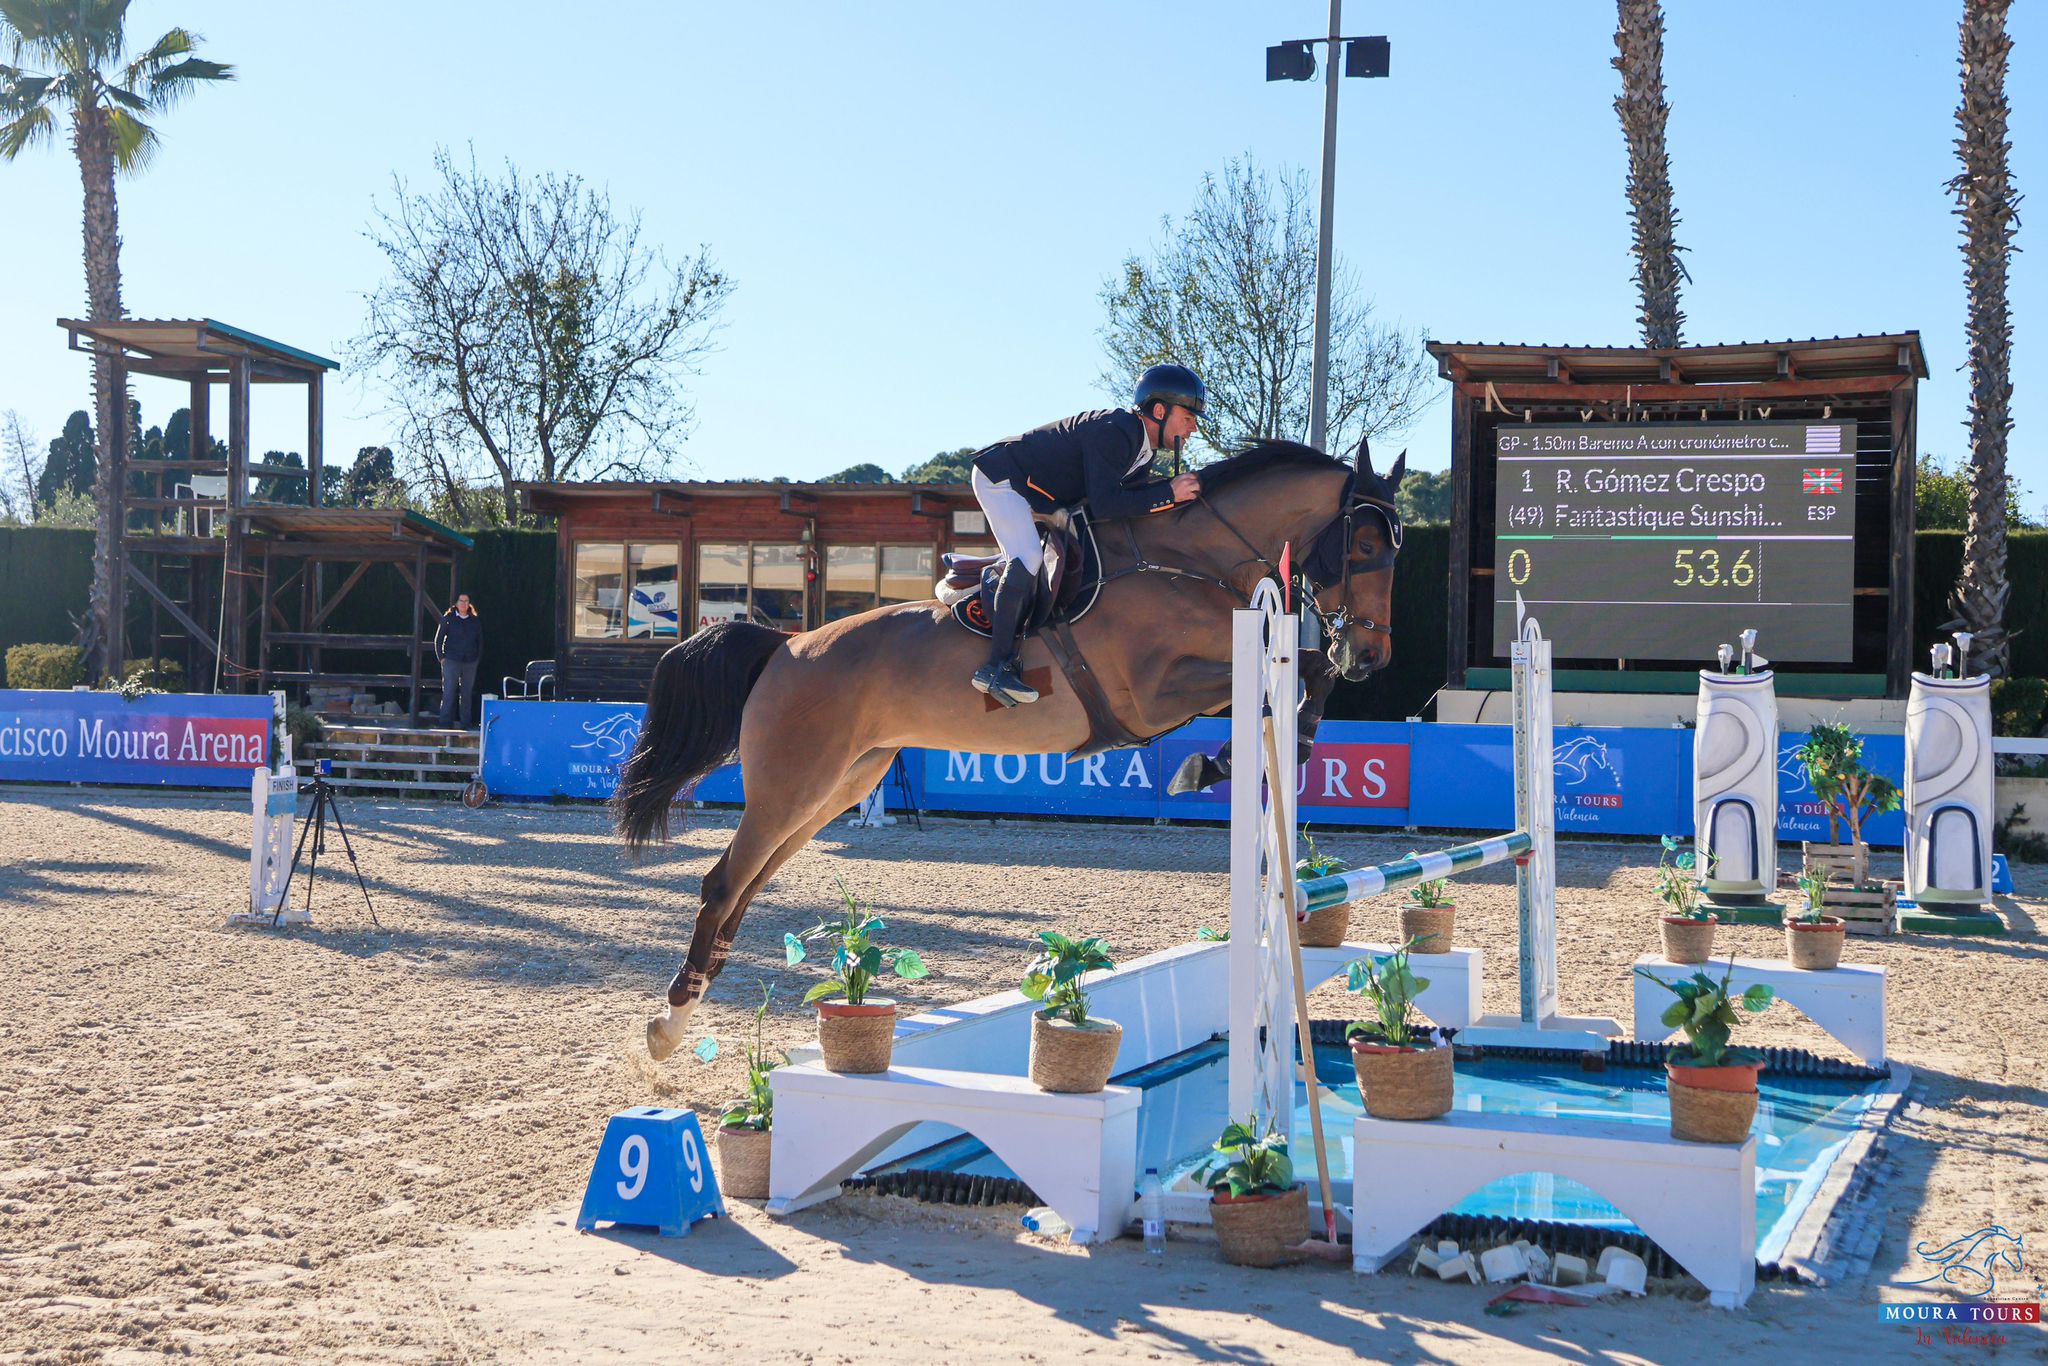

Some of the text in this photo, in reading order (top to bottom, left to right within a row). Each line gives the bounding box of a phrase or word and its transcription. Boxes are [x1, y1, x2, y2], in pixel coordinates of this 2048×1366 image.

[1499, 436, 1520, 451] GP
[1532, 436, 1576, 450] 1.50m
[1579, 435, 1634, 450] Baremo
[1637, 434, 1648, 449] A
[1651, 438, 1677, 449] con
[1680, 434, 1766, 449] cronómetro
[1522, 468, 1766, 497] 1 R. Gómez Crespo
[1508, 504, 1544, 528] (49)
[1556, 503, 1685, 531] Fantastique
[1807, 505, 1836, 520] ESP
[1508, 549, 1531, 585] 0
[1673, 549, 1755, 587] 53.6
[78, 718, 170, 761] Moura
[177, 721, 264, 764] Arena
[572, 764, 610, 774] MOURA
[945, 750, 1153, 789] MOURA
[272, 780, 294, 793] FINISH
[1555, 807, 1600, 821] Valencia
[1576, 796, 1618, 807] TOURS
[616, 1134, 650, 1200] 9
[682, 1129, 703, 1193] 9
